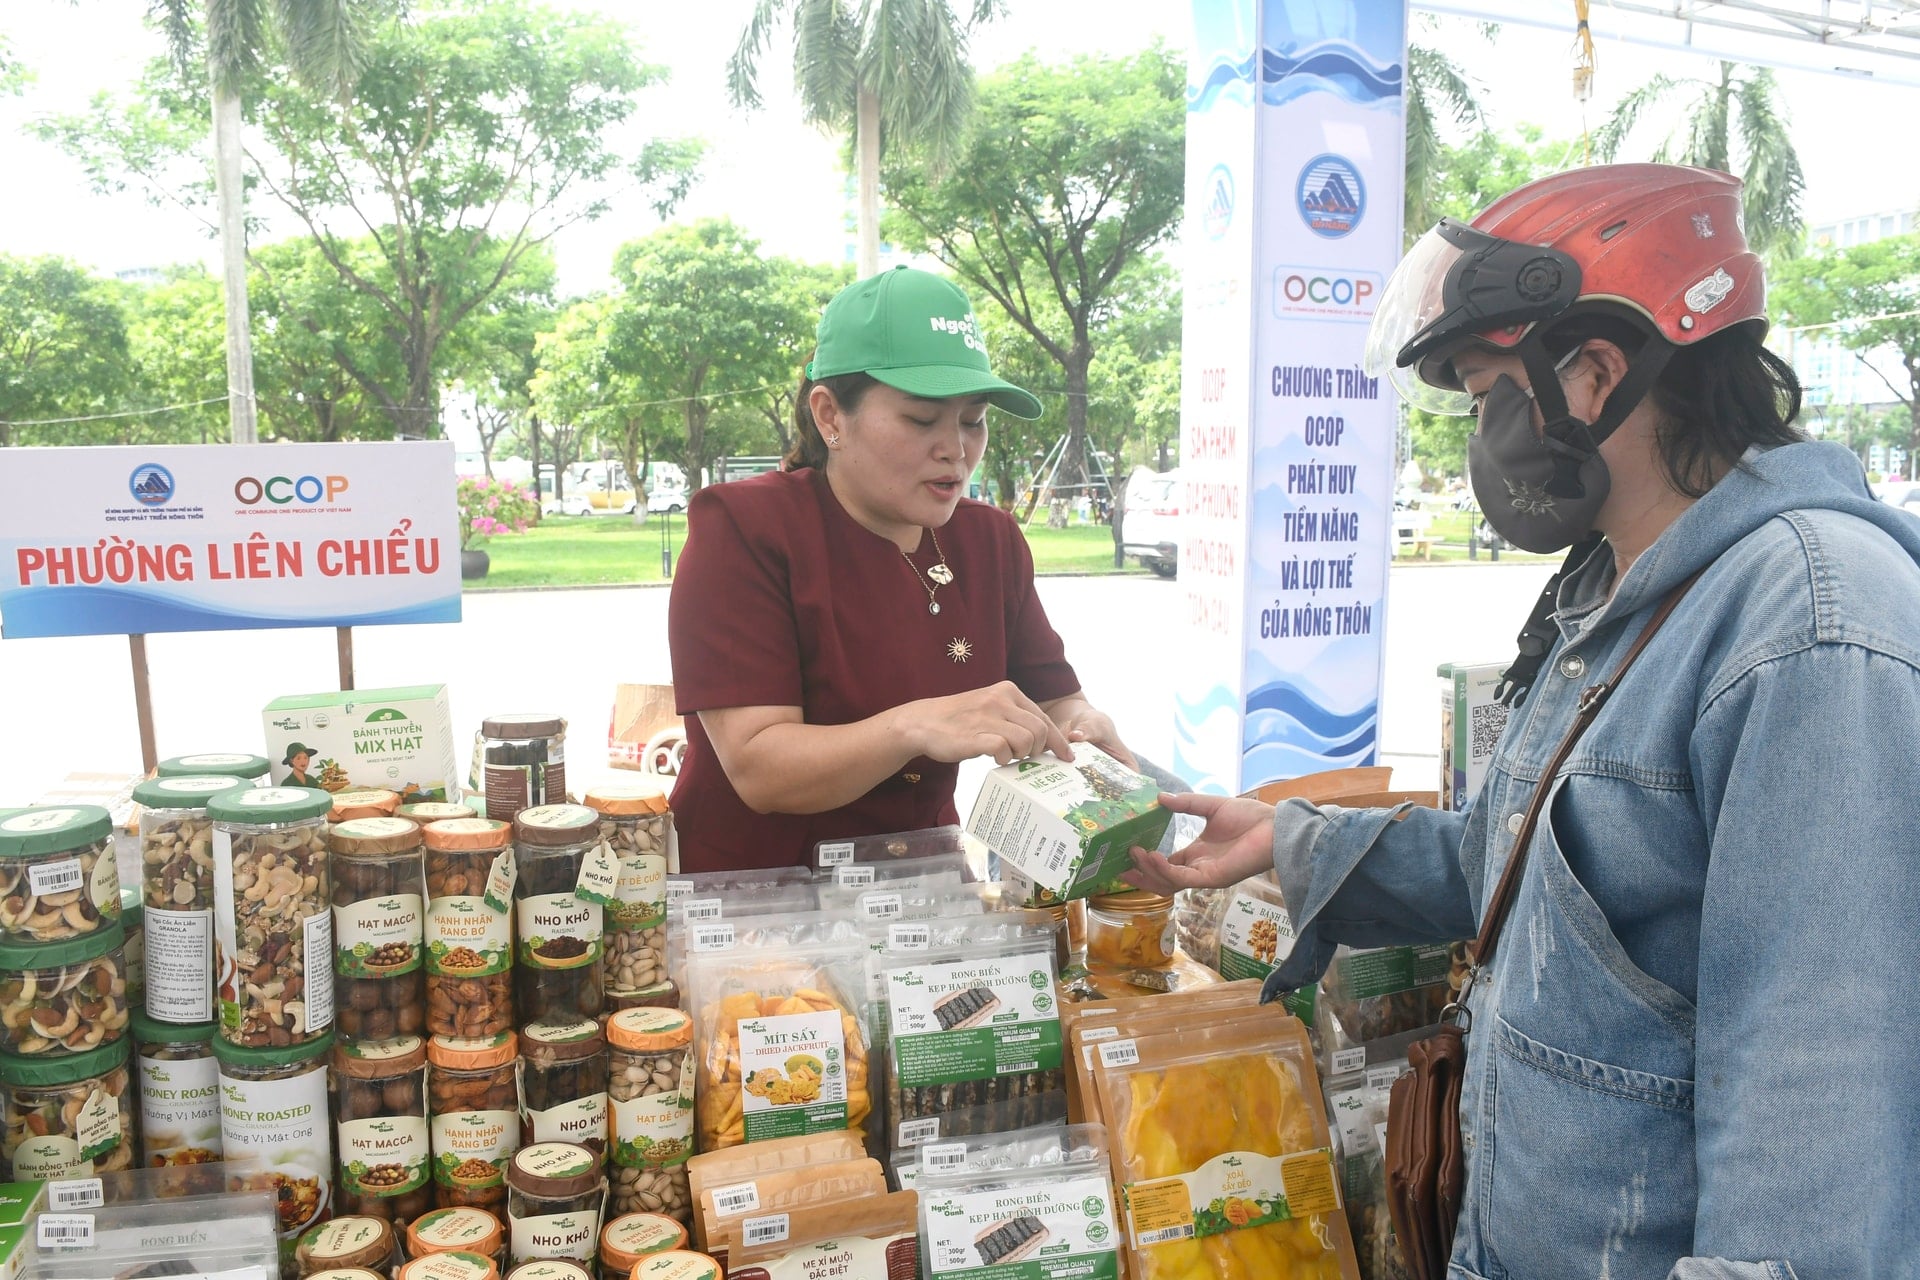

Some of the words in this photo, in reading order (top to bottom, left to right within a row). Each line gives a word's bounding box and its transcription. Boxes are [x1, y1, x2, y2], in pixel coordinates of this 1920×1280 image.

[1284, 275, 1372, 305] OCOP
[1272, 365, 1332, 398] CHƯƠNG
[1336, 364, 1379, 399] TRÌNH
[1305, 415, 1344, 446] OCOP
[1287, 459, 1325, 494] PHÁT
[1328, 465, 1357, 494] HUY
[234, 475, 349, 504] OCOP
[1284, 505, 1317, 542] TIỀM
[1320, 507, 1359, 542] NĂNG
[17, 535, 194, 585] PHƯỜNG
[208, 531, 302, 580] LIÊN
[317, 518, 440, 577] CHIỂU
[1281, 555, 1299, 590] VÀ
[1303, 557, 1324, 596] LỢI
[1328, 553, 1356, 589] THẾ
[1260, 600, 1290, 638] CỦA
[1294, 602, 1331, 637] NÔNG
[1336, 601, 1372, 635] THÔN
[353, 727, 380, 738] BÁNH
[383, 722, 422, 736] THUYỀN
[354, 738, 386, 755] MIX
[391, 736, 424, 755] HẠT
[585, 872, 599, 882] NHO
[600, 875, 613, 885] KHÔ
[358, 920, 379, 932] HẠT
[384, 913, 416, 928] MACCA
[464, 914, 493, 924] NHÂN
[534, 915, 562, 926] NHO
[566, 909, 590, 925] KHÔ
[440, 928, 467, 936] RANG
[951, 970, 976, 980] RONG
[979, 965, 1001, 977] BIỂN
[928, 983, 947, 994] KẸP
[996, 974, 1028, 986] DƯỠNG
[764, 1032, 788, 1045] MÍT
[792, 1027, 817, 1042] SẤY
[994, 1028, 1018, 1037] PREMIUM
[1018, 1026, 1042, 1034] QUALITY
[756, 1046, 781, 1056] DRIED
[782, 1041, 830, 1053] JACKFRUIT
[144, 1086, 178, 1100] HONEY
[181, 1084, 220, 1100] ROAST
[222, 1104, 254, 1121] HONEY
[257, 1104, 312, 1122] ROASTED
[560, 1119, 588, 1132] NHO
[590, 1107, 606, 1126] KHÔ
[267, 1130, 290, 1143] Mật
[292, 1126, 313, 1140] Ong
[476, 1124, 504, 1136] NHÂN
[352, 1138, 372, 1150] HẠT
[376, 1134, 413, 1148] MACCA
[451, 1140, 480, 1148] RANG
[38, 1157, 62, 1171] ĐỒNG
[534, 1159, 556, 1170] NHO
[557, 1150, 577, 1162] KHÔ
[995, 1198, 1024, 1208] RONG
[1026, 1192, 1051, 1204] BIỂN
[944, 1208, 964, 1217] Oanh
[968, 1213, 990, 1226] KẸP
[1016, 1207, 1042, 1218] DINH
[1044, 1201, 1080, 1216] DƯỠNG
[141, 1235, 175, 1248] RONG
[532, 1235, 562, 1246] NHO
[566, 1226, 590, 1245] KHÔ
[937, 1240, 952, 1248] NET:
[550, 1246, 575, 1255] RAISINS
[803, 1261, 816, 1270] ME
[818, 1256, 828, 1266] XÍ
[831, 1251, 854, 1266] MUỘI
[1040, 1263, 1068, 1272] PREMIUM
[1070, 1259, 1096, 1268] QUALITY
